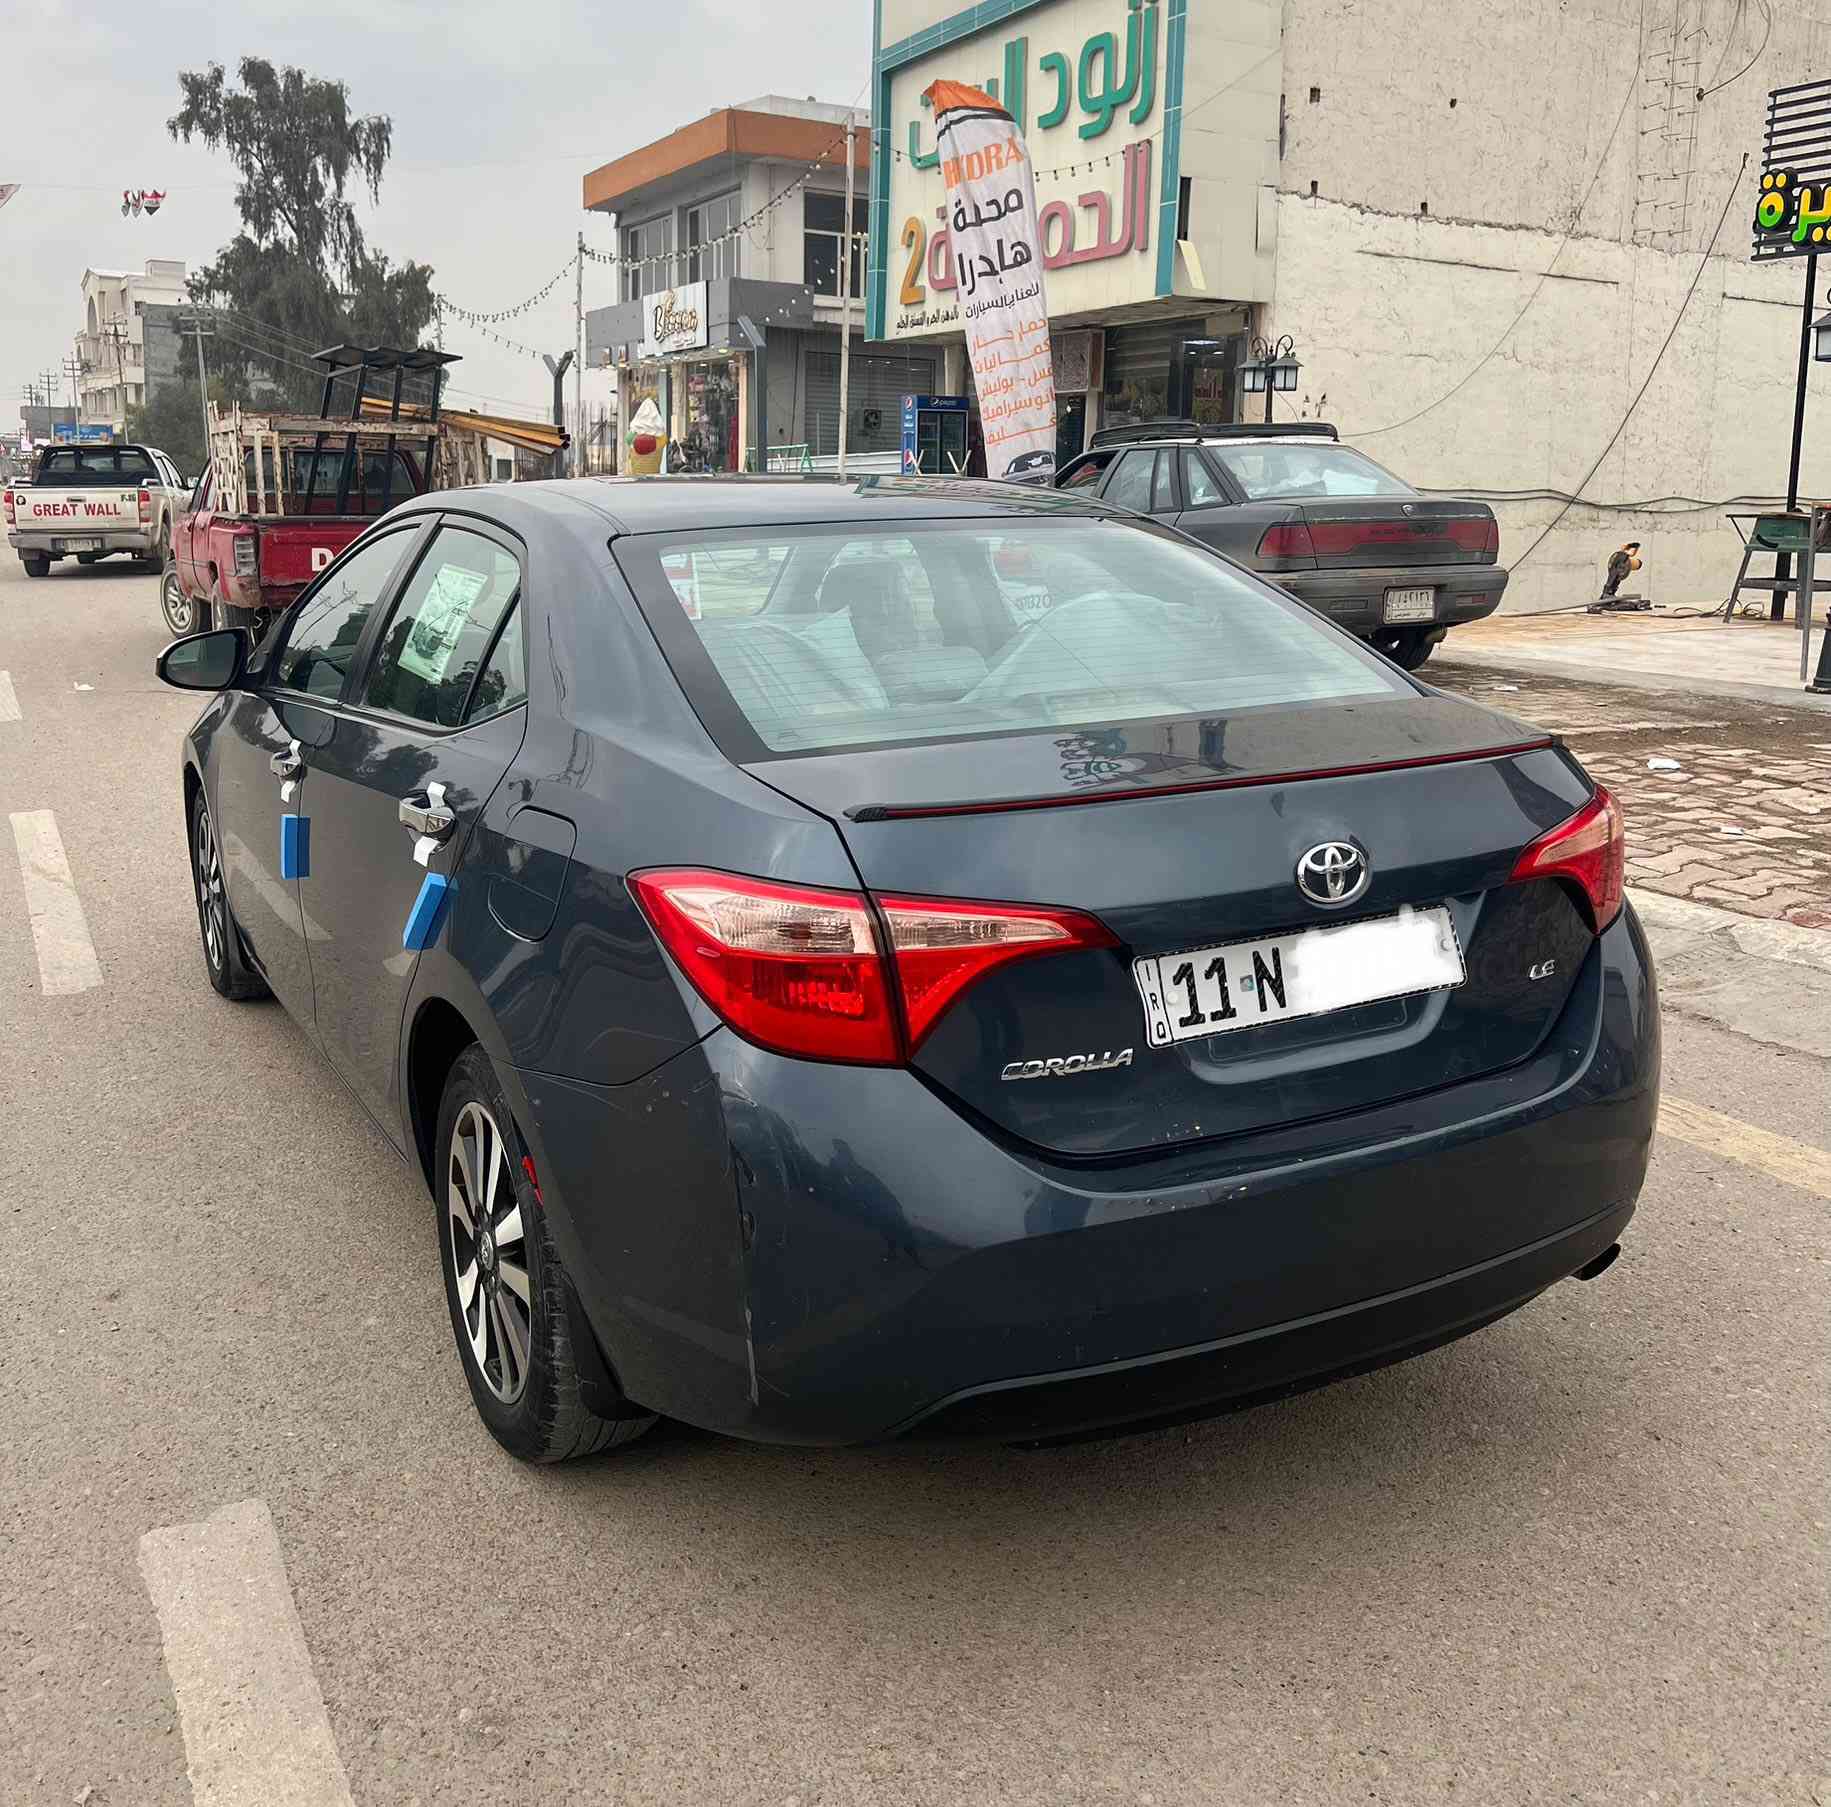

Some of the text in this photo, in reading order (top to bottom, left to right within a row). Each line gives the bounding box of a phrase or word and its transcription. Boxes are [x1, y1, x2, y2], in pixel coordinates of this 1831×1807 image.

[944, 136, 1025, 188] HDRA
[900, 216, 927, 305] 2
[957, 238, 1032, 296] هادرا
[33, 503, 121, 516] GREAT WALL
[1172, 946, 1287, 1028] 11 N
[1529, 959, 1555, 981] LE
[1001, 1047, 1133, 1081] COROLLA
